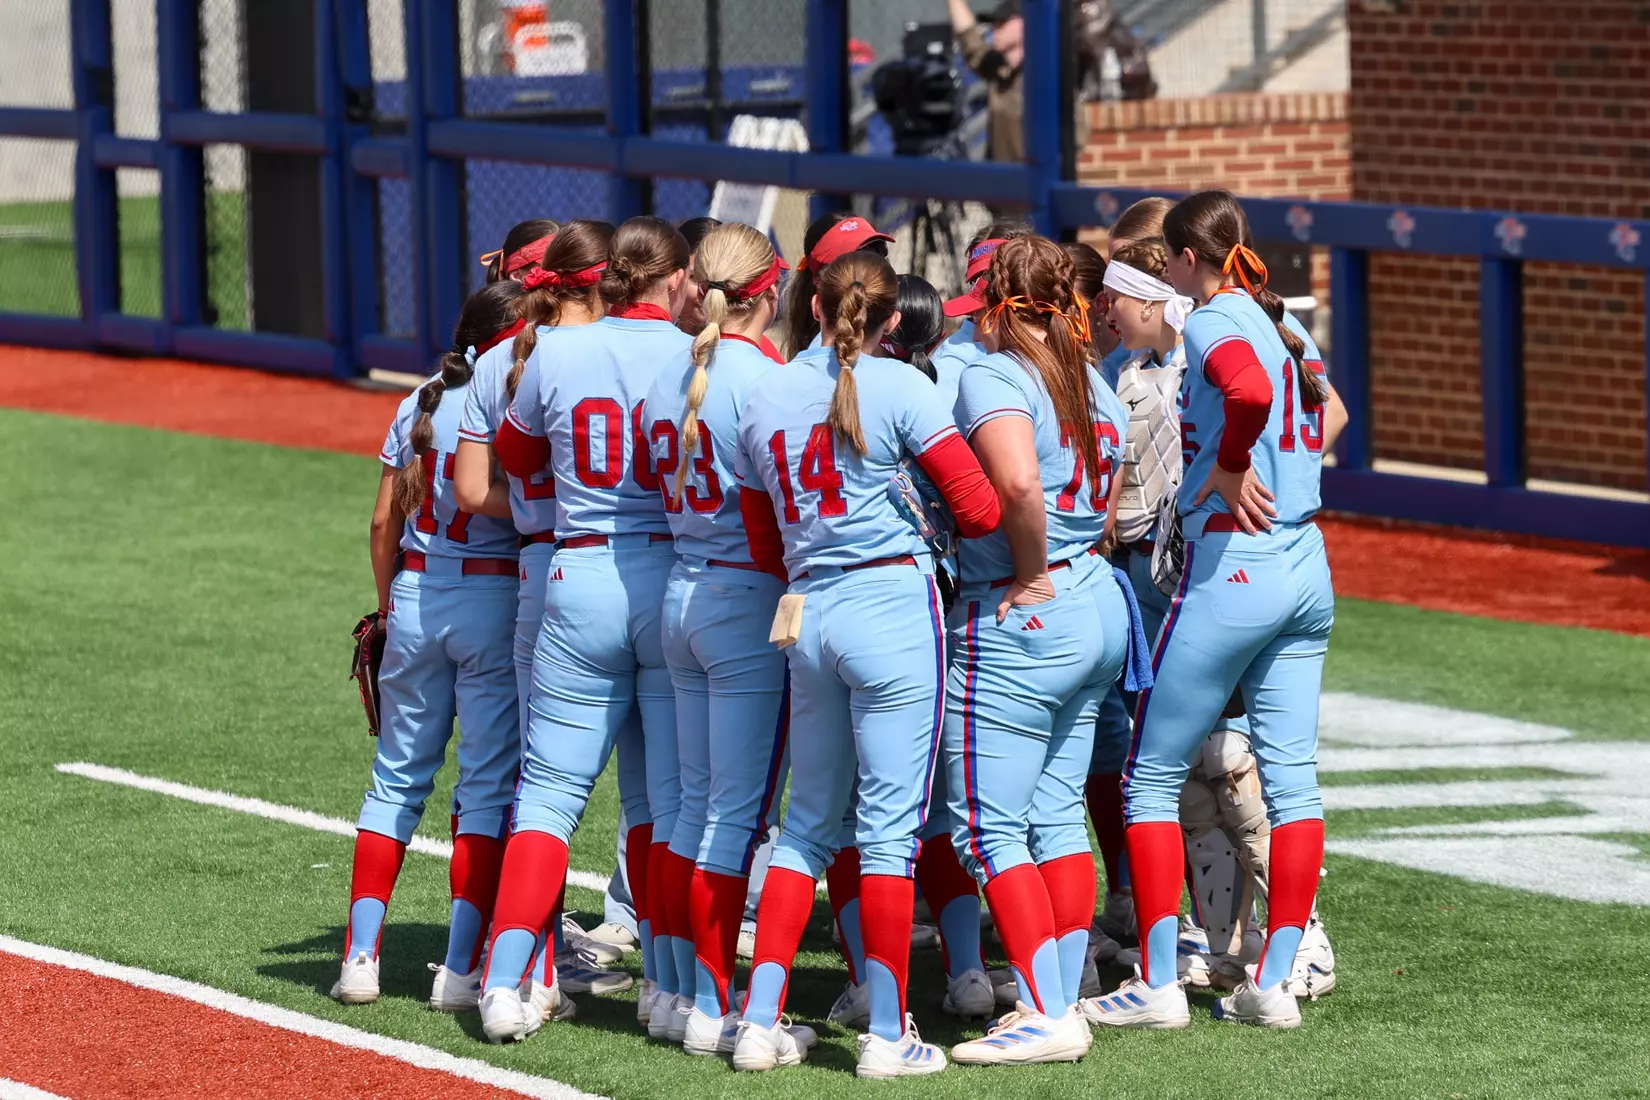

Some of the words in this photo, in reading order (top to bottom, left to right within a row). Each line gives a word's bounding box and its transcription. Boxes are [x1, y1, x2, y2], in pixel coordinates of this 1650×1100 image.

[1279, 357, 1325, 453] 15
[651, 419, 724, 513] 23
[769, 423, 848, 525] 14
[1056, 420, 1120, 513] 76
